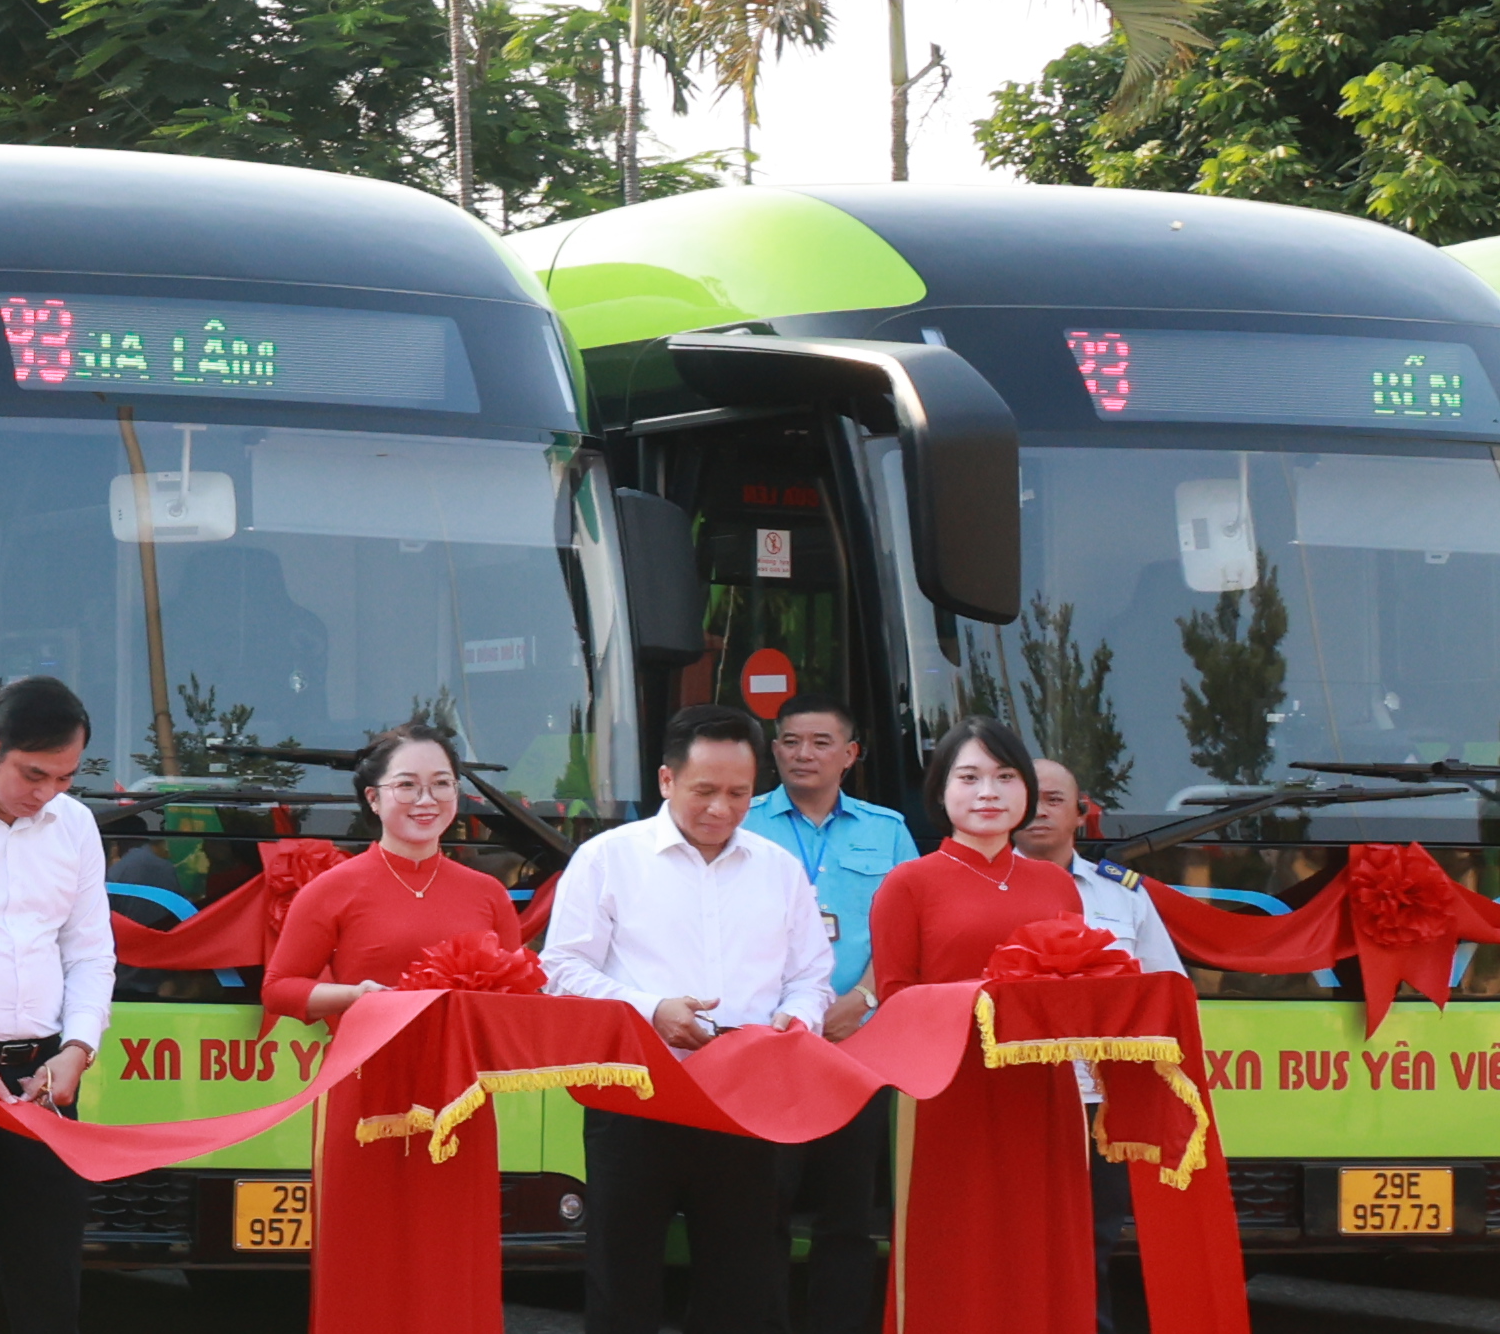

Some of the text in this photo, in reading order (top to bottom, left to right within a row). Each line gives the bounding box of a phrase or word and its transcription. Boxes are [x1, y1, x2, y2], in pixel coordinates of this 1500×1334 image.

[200, 1038, 279, 1082] BUS
[1279, 1049, 1350, 1091] BUS
[1361, 1040, 1436, 1091] YÊN
[273, 1185, 308, 1214] 29
[1373, 1172, 1422, 1200] 29E
[1353, 1203, 1442, 1231] 957.73
[250, 1218, 312, 1247] 957.
